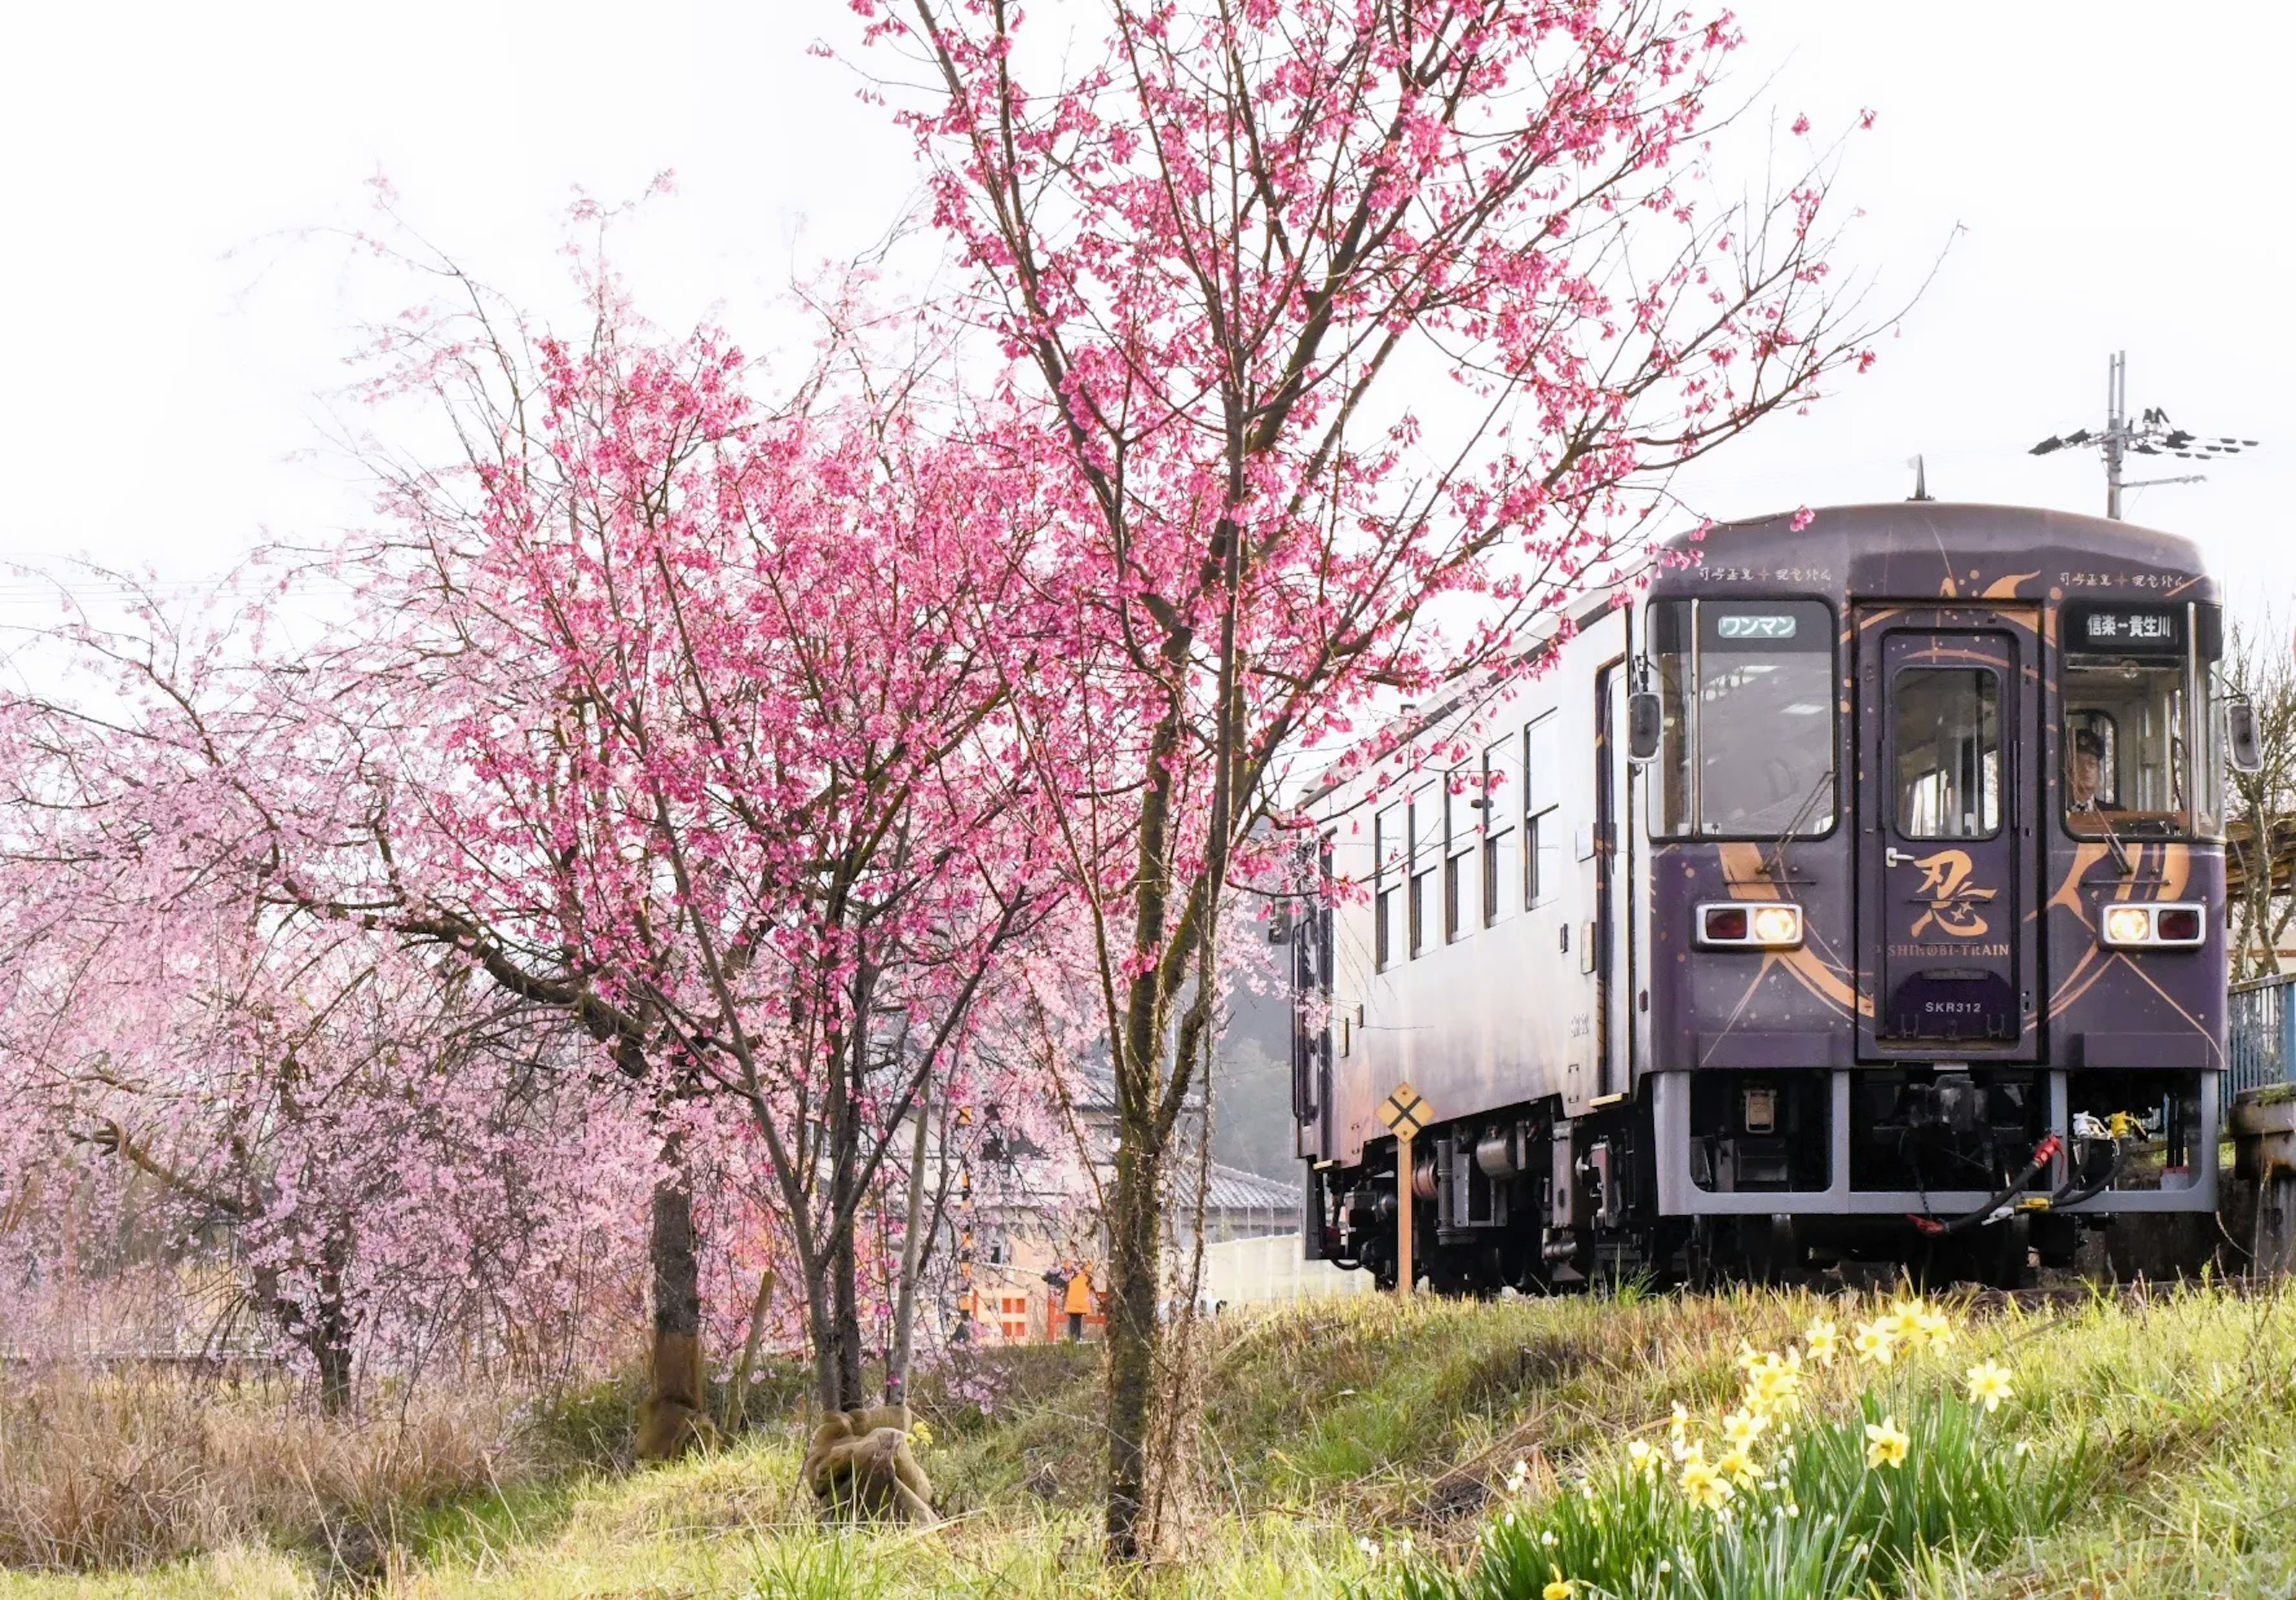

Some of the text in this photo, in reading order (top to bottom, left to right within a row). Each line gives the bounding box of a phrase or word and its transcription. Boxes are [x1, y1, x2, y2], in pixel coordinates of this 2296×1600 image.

[1722, 616, 1795, 635] ワンマン
[1910, 849, 1998, 937] 忍
[1925, 1002, 1981, 1012] SKR312
